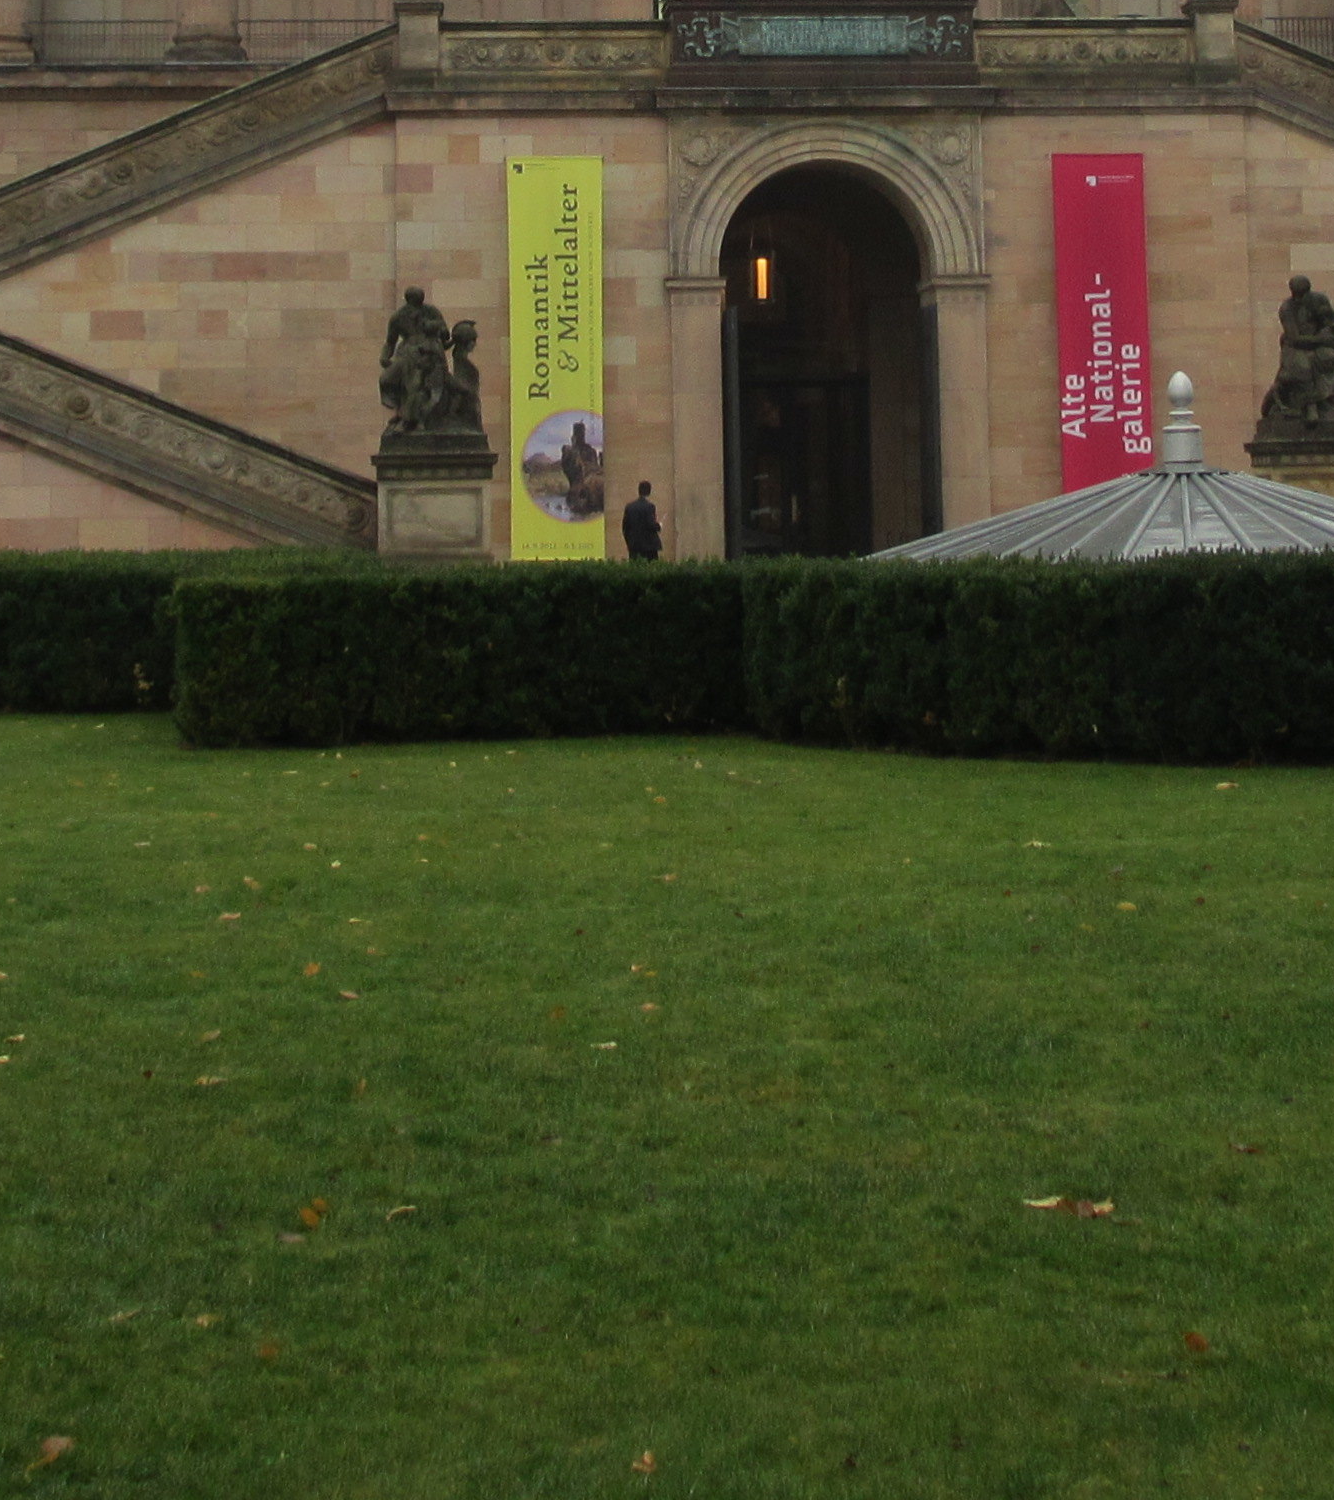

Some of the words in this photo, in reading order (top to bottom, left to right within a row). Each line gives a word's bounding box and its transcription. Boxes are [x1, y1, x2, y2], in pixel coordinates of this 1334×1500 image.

[524, 253, 551, 401] Romantik
[553, 183, 580, 345] Mittelalter
[556, 353, 579, 374] &
[1061, 373, 1086, 439] Alte
[1084, 272, 1115, 424] National-
[1114, 342, 1152, 455] galerie
